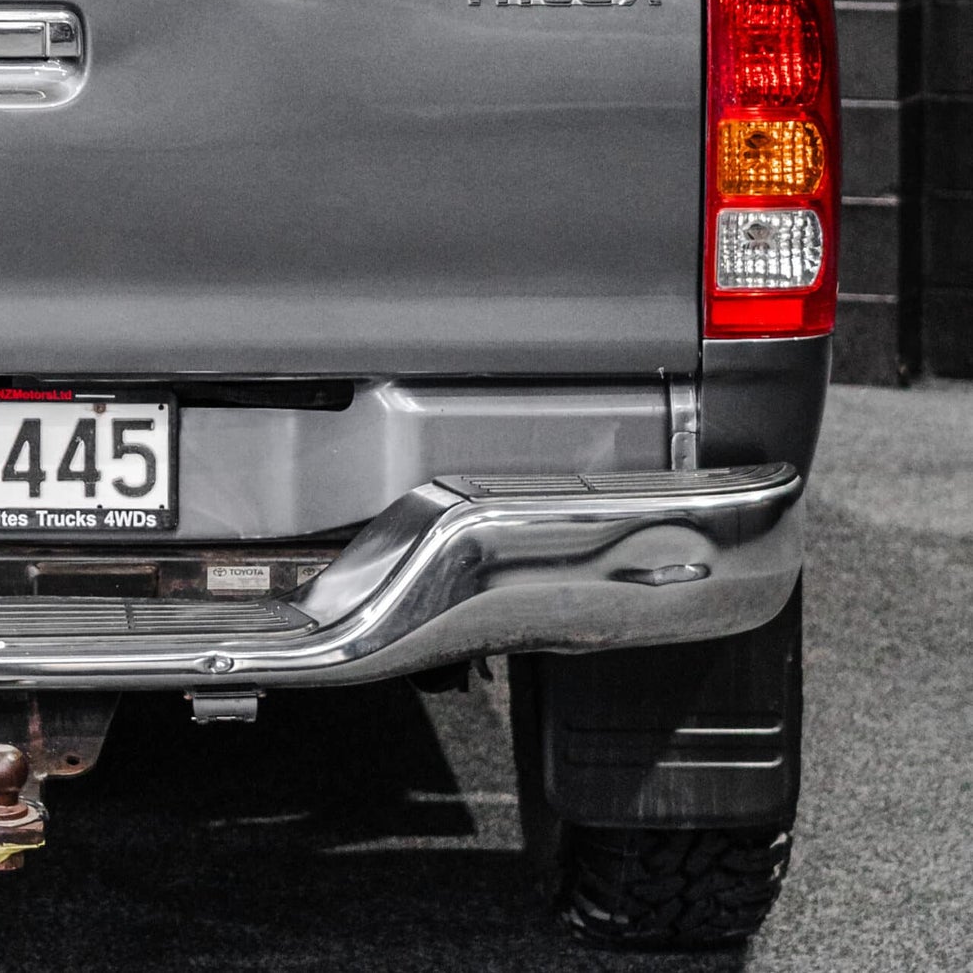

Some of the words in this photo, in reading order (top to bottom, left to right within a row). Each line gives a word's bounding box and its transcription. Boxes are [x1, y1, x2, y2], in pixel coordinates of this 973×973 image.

[36, 510, 96, 526] Trucks
[104, 510, 157, 527] 4WDs
[229, 568, 264, 576] TOYOTA
